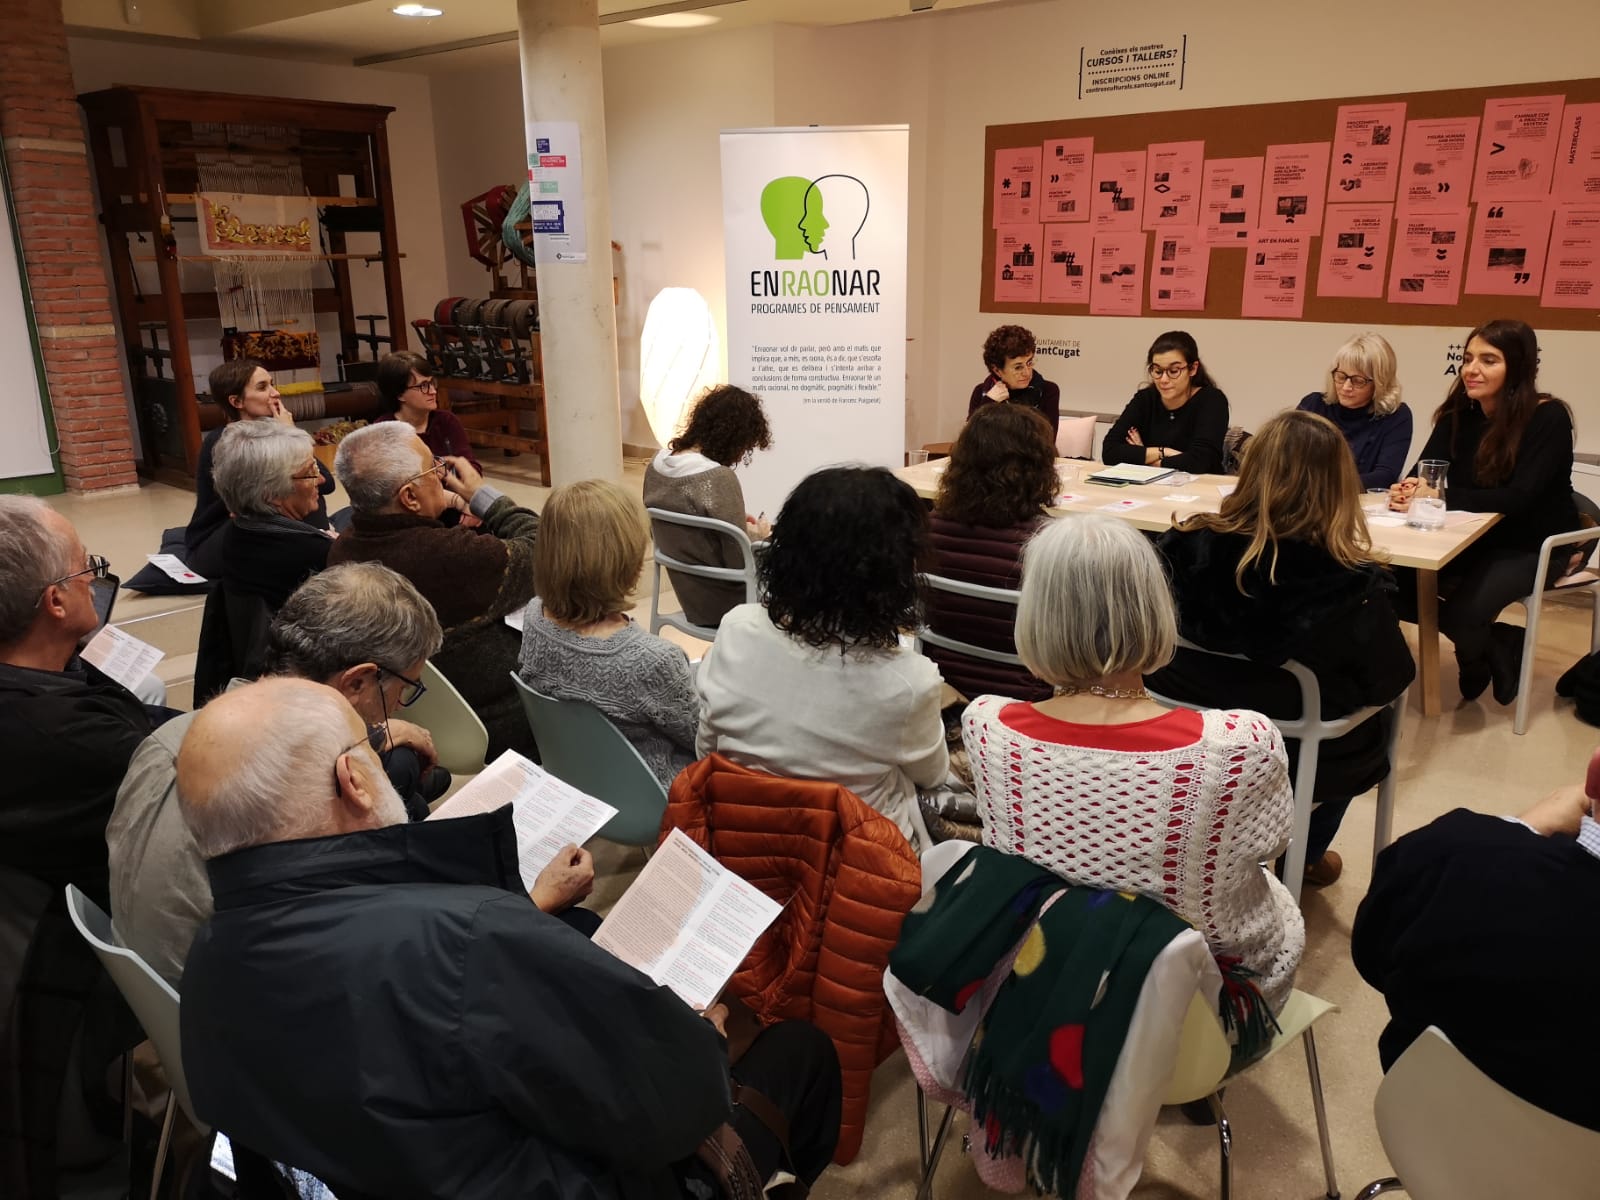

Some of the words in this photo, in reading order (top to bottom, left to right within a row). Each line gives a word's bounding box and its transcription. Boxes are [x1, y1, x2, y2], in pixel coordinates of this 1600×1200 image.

[1086, 55, 1123, 67] CURSOS
[1126, 55, 1130, 63] I
[1132, 49, 1178, 62] TALLERS?
[1100, 48, 1127, 56] Conèixes
[1092, 74, 1141, 85] INSCRIPCIONS
[1143, 71, 1170, 80] ONLINE
[1568, 116, 1582, 164] MASTERCLASS
[751, 269, 880, 297] ENRAONAR
[751, 303, 807, 314] PROGRAMES
[810, 303, 822, 313] DE
[825, 302, 880, 313] PENSAMENT
[780, 345, 789, 353] vol
[870, 345, 881, 353] que
[1036, 346, 1080, 358] antCugat
[847, 355, 858, 363] que
[779, 366, 788, 374] que
